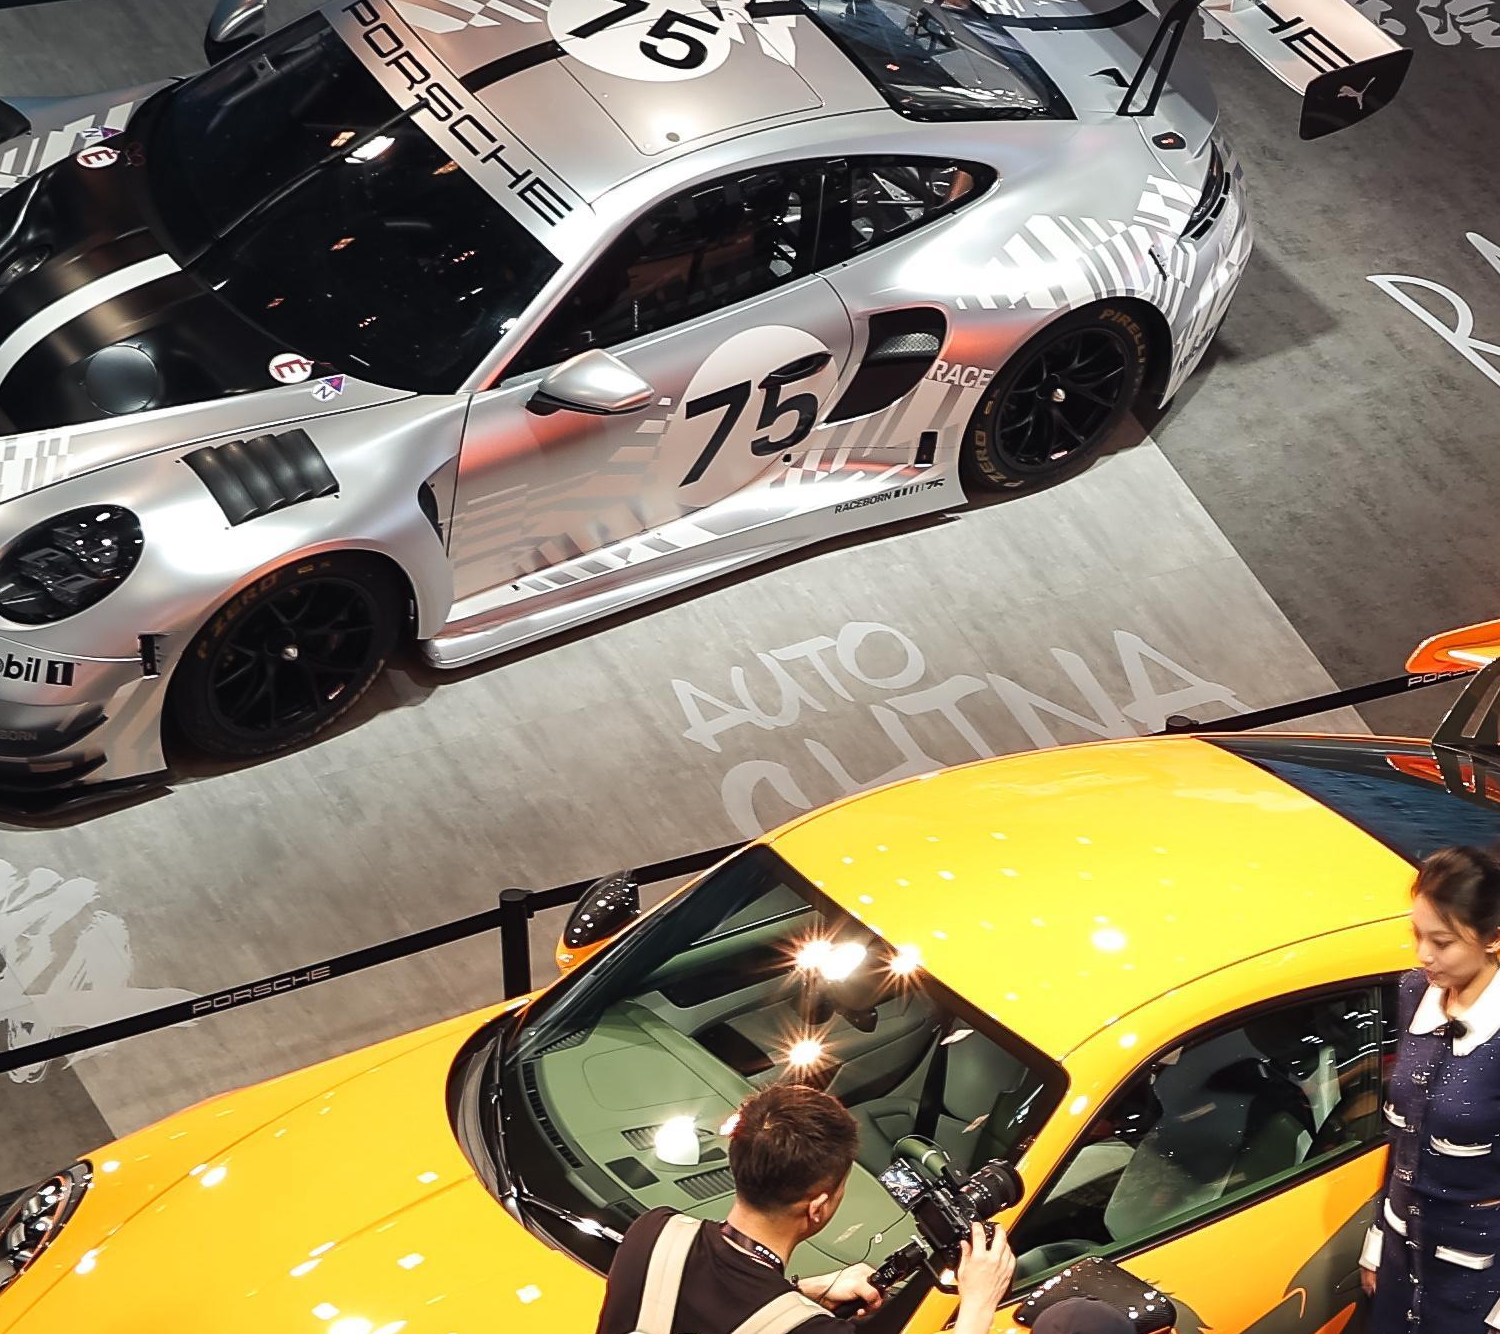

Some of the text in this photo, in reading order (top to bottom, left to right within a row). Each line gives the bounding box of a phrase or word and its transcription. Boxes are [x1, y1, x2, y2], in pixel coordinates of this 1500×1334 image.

[342, 1, 574, 227] PORSCHE
[1099, 308, 1148, 365] PIRELLI
[680, 378, 819, 488] 75
[974, 428, 1006, 484] ZERO
[834, 490, 892, 515] RACEBORN
[672, 621, 927, 753] AUTO
[192, 966, 331, 1015] PORSCHE
